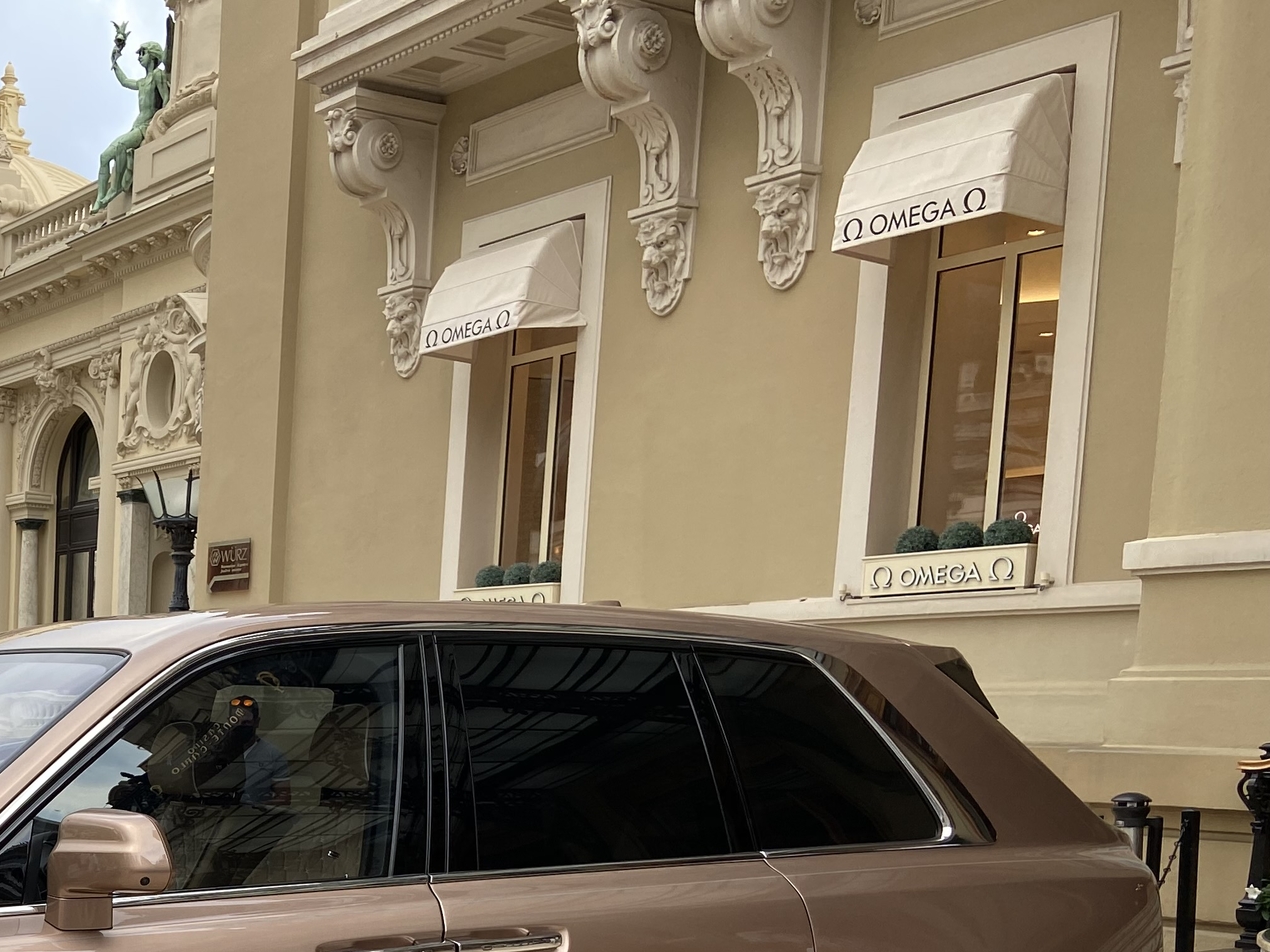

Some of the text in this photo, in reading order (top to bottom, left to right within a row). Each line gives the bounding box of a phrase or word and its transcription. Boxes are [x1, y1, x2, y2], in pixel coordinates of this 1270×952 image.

[869, 198, 956, 235] OMEGA
[441, 317, 492, 344] OMEGA
[220, 546, 248, 562] WÜRZ
[899, 562, 983, 588] OMEGA
